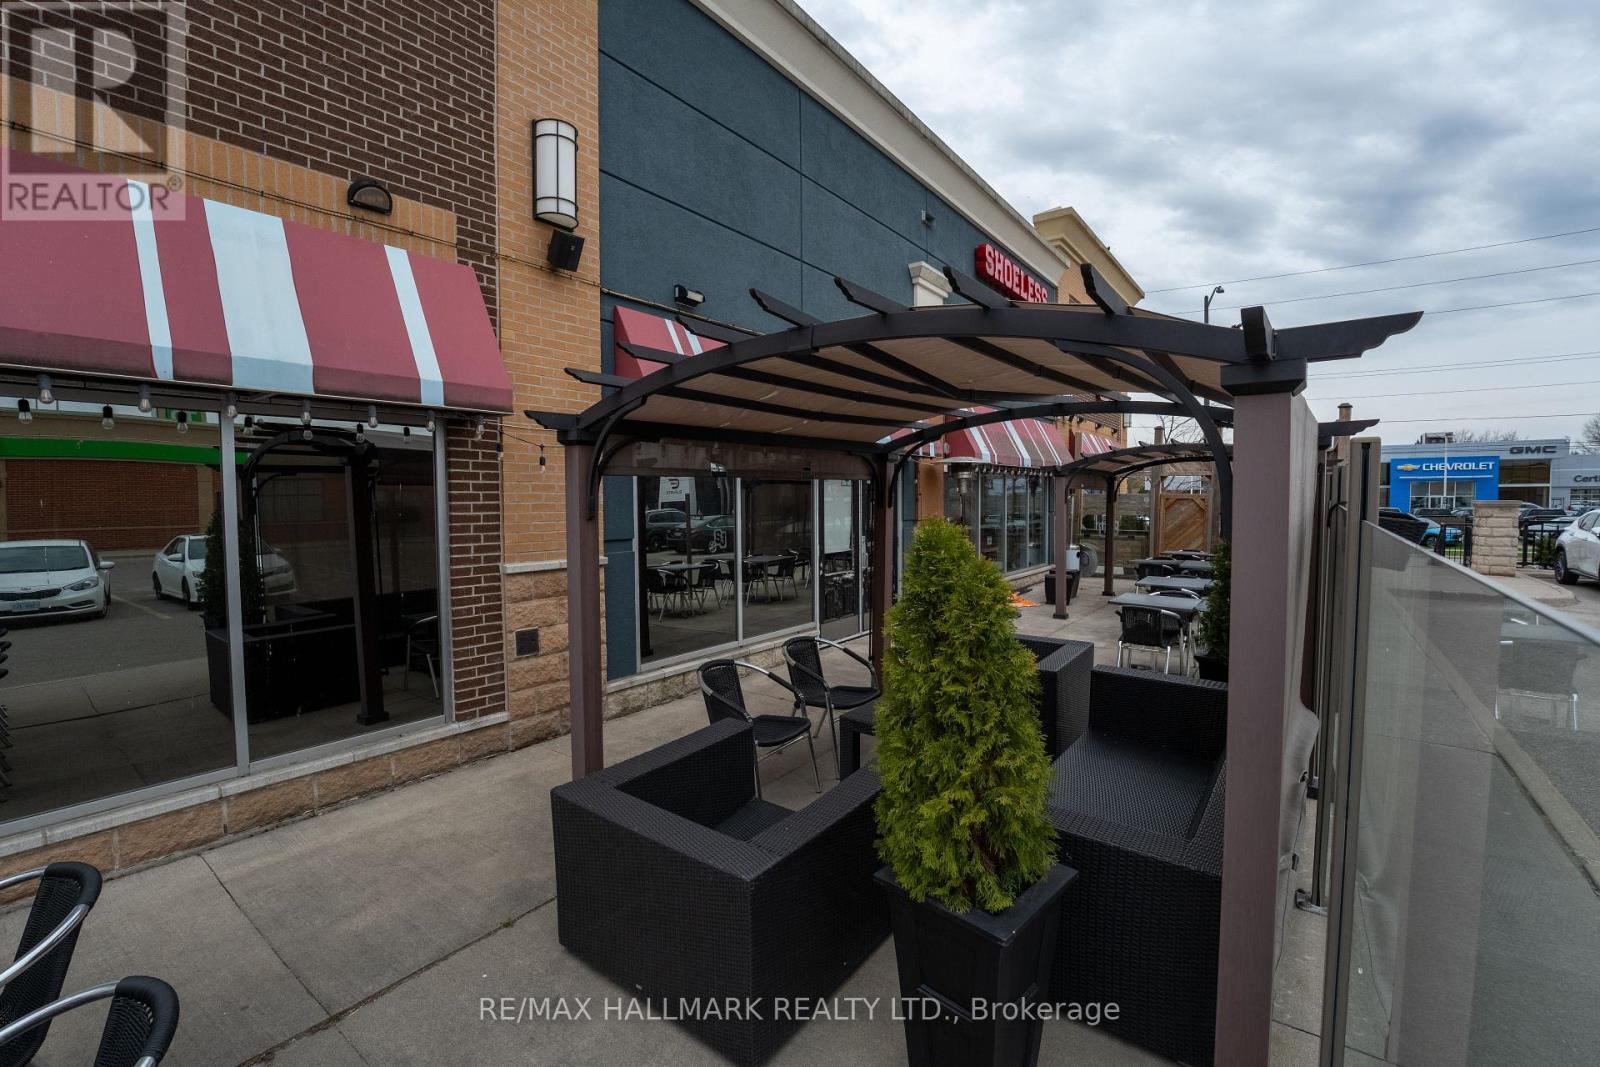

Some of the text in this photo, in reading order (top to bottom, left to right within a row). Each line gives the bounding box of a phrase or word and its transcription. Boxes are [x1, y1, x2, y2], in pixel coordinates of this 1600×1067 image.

[985, 243, 1048, 304] SHOELESS
[1509, 445, 1557, 454] GMC
[1422, 461, 1495, 471] CHEVROLET
